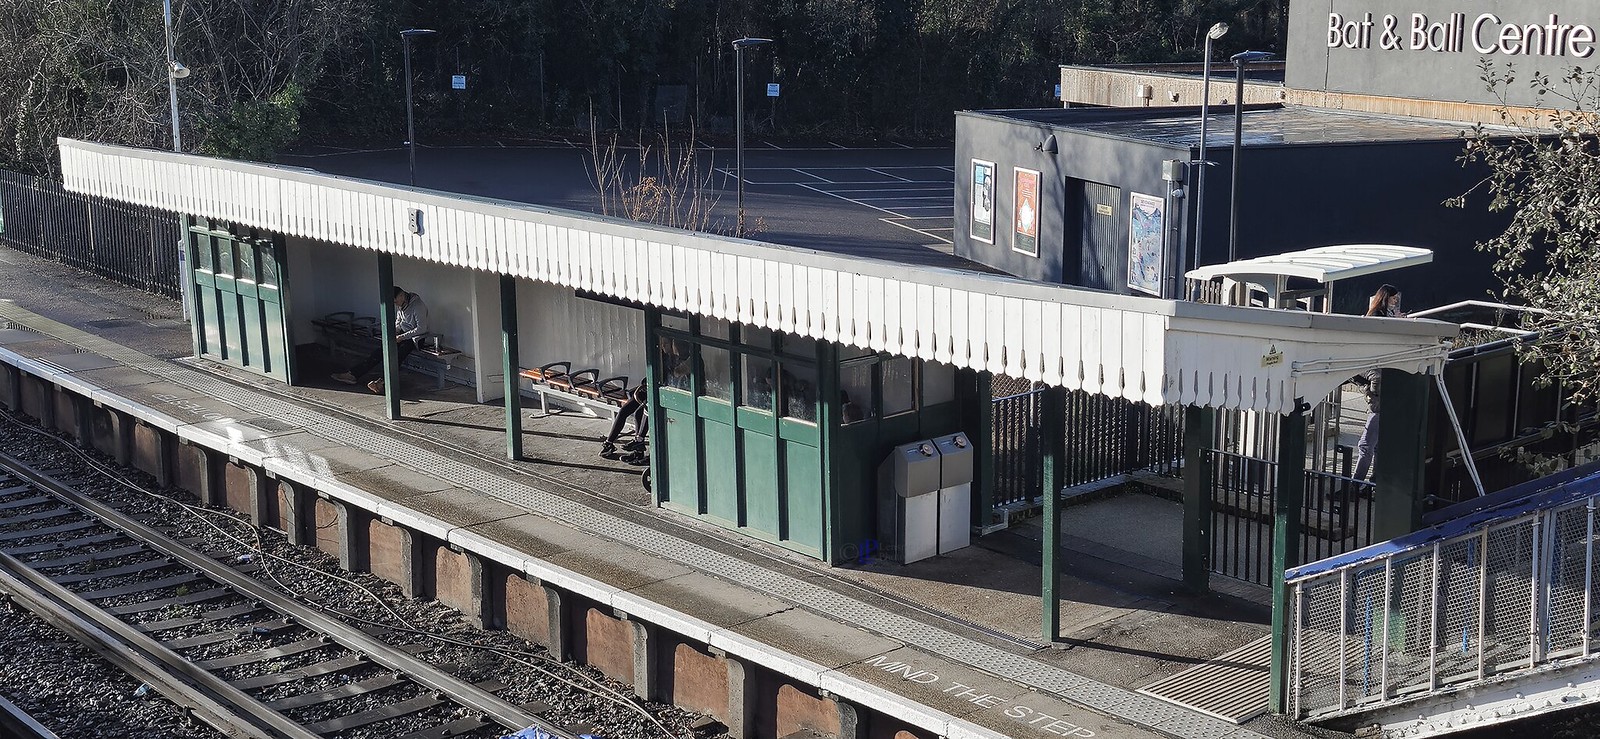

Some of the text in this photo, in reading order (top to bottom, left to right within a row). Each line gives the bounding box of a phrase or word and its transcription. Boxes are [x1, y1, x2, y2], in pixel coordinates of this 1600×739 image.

[1327, 12, 1596, 58] Bat & Ball Centre
[865, 655, 1095, 739] MIND THE STEP
